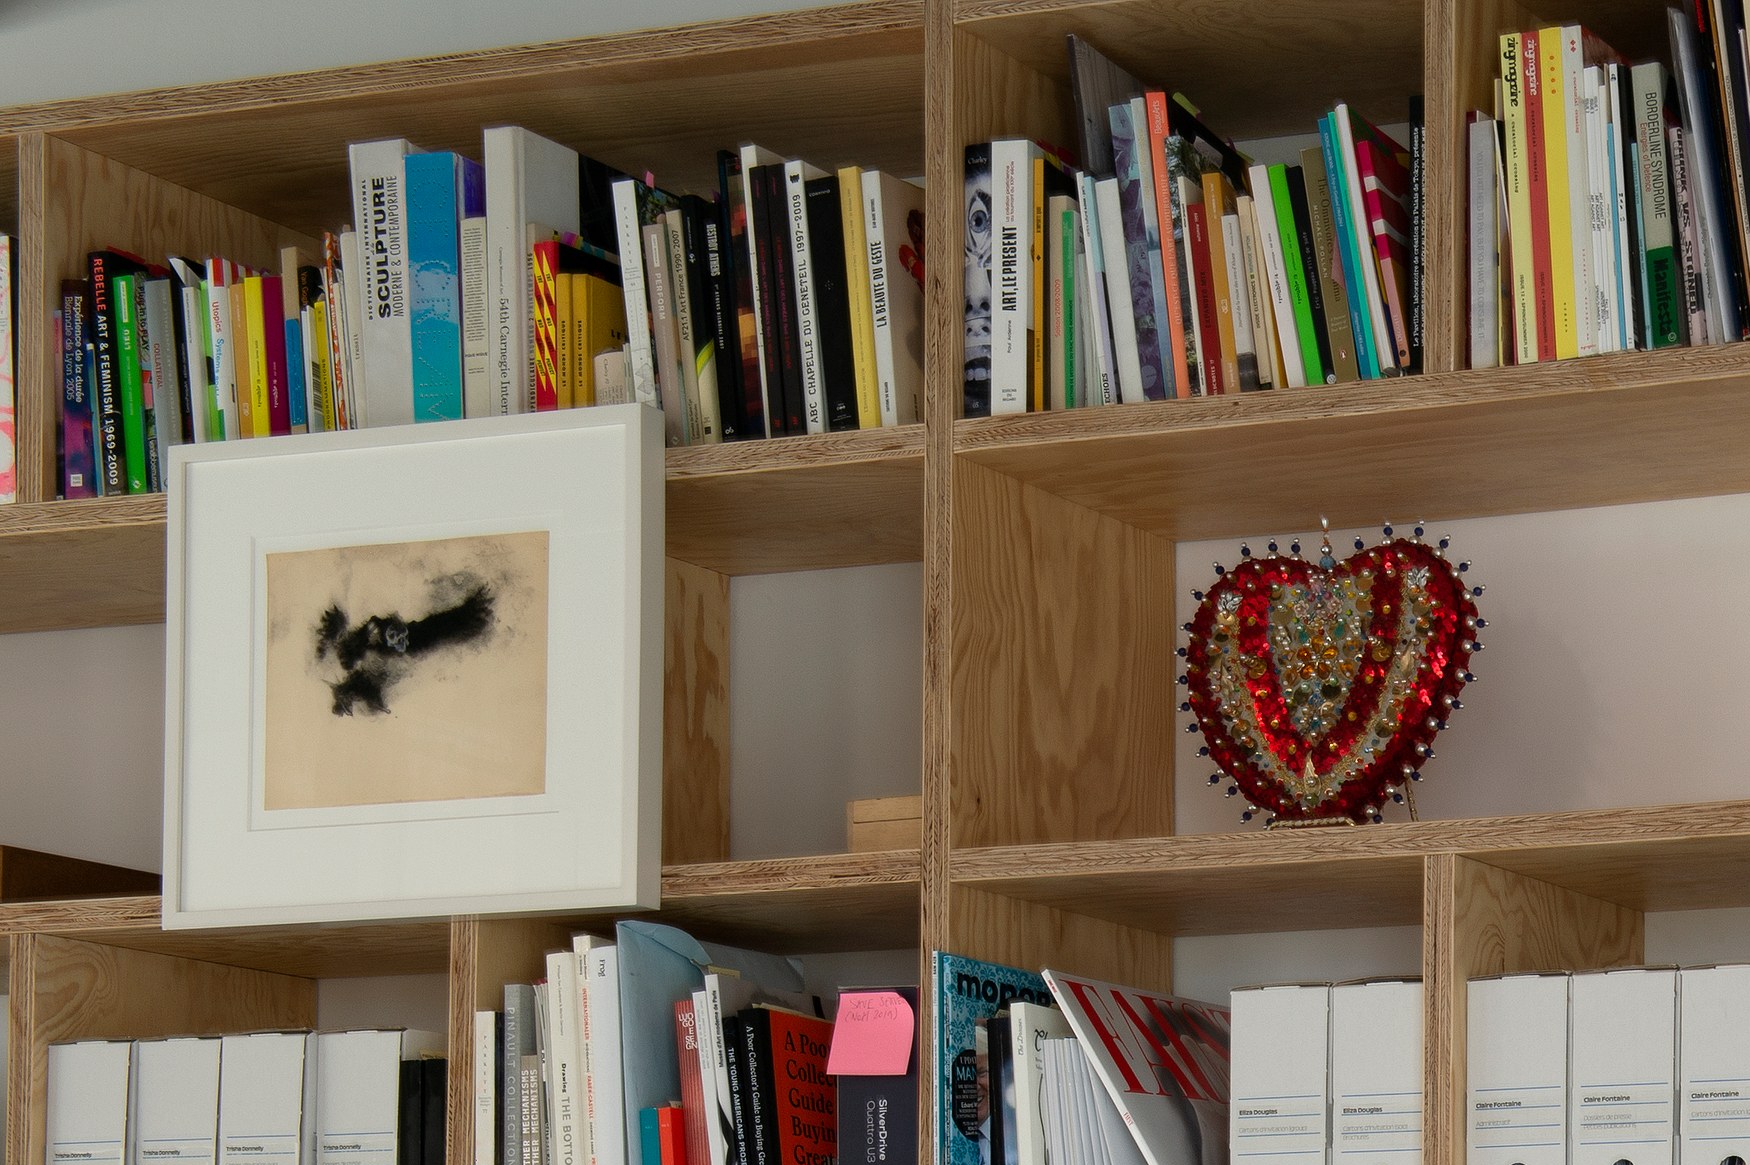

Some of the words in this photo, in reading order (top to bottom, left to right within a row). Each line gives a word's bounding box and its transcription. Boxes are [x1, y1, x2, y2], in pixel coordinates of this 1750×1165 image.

[1646, 92, 1662, 157] BORDERLINE
[1652, 160, 1667, 220] SYNDROME
[361, 179, 371, 252] INTERNATIONAL
[386, 175, 402, 257] CONTEMPORAINE
[792, 194, 806, 253] 1997-2009
[372, 177, 391, 319] SCULPTURE
[870, 240, 882, 265] GESTE
[94, 259, 106, 310] REBELLE
[366, 256, 374, 320] DICTIONNAIRE
[390, 271, 405, 317] MODERNE
[654, 272, 666, 320] PERFORM
[799, 259, 812, 316] GENETEIL
[872, 267, 883, 279] DU
[500, 298, 509, 321] 54th
[873, 282, 886, 313] BEAUTE
[877, 314, 887, 328] LA
[97, 315, 109, 337] ART
[501, 324, 511, 376] Carnegie
[803, 320, 812, 337] DU
[101, 354, 113, 415] FEMINISM
[804, 340, 817, 395] CHAPELLE
[810, 402, 819, 424] ABC
[107, 419, 118, 486] 1969-2009
[507, 1007, 516, 1069] PINAULT
[784, 1030, 796, 1051] A
[799, 1034, 828, 1057] Poo
[560, 1063, 568, 1094] Drawing
[730, 1065, 739, 1093] YOUNG
[788, 1090, 833, 1115] Guide
[521, 1069, 531, 1137] MECHANISMS
[562, 1096, 571, 1121] THE
[734, 1096, 745, 1145] AMERICANS
[867, 1101, 875, 1146] Quattro
[791, 1117, 837, 1145] Buyin
[878, 1099, 888, 1161] SilverDrive
